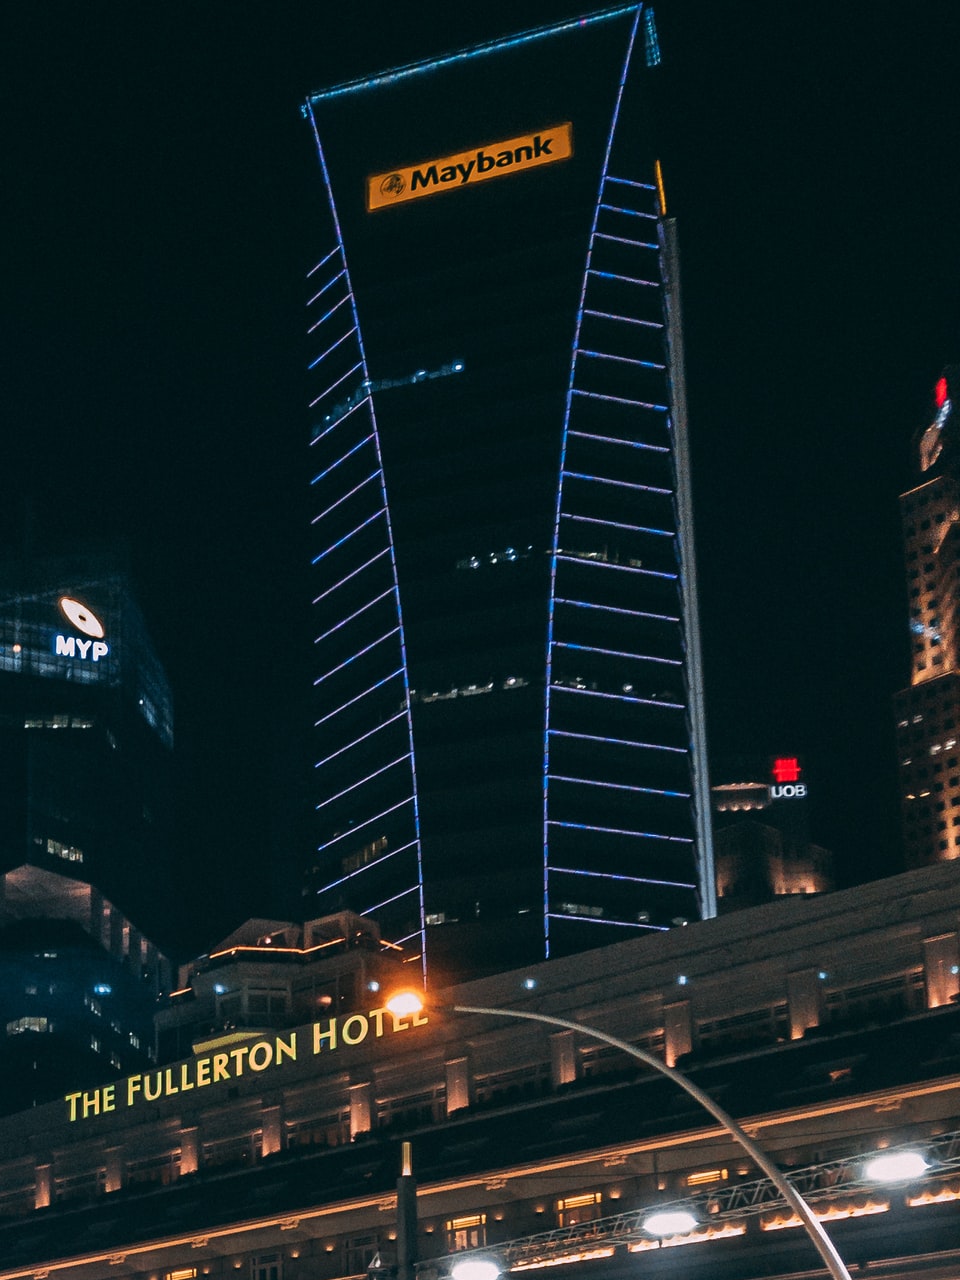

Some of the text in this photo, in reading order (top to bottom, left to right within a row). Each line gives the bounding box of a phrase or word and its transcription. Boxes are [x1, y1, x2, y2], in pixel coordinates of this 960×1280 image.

[410, 136, 553, 191] Maybank
[55, 635, 109, 661] MYP
[771, 784, 806, 798] UOB
[65, 1085, 116, 1122] THE
[127, 1032, 297, 1106] FULLERTON
